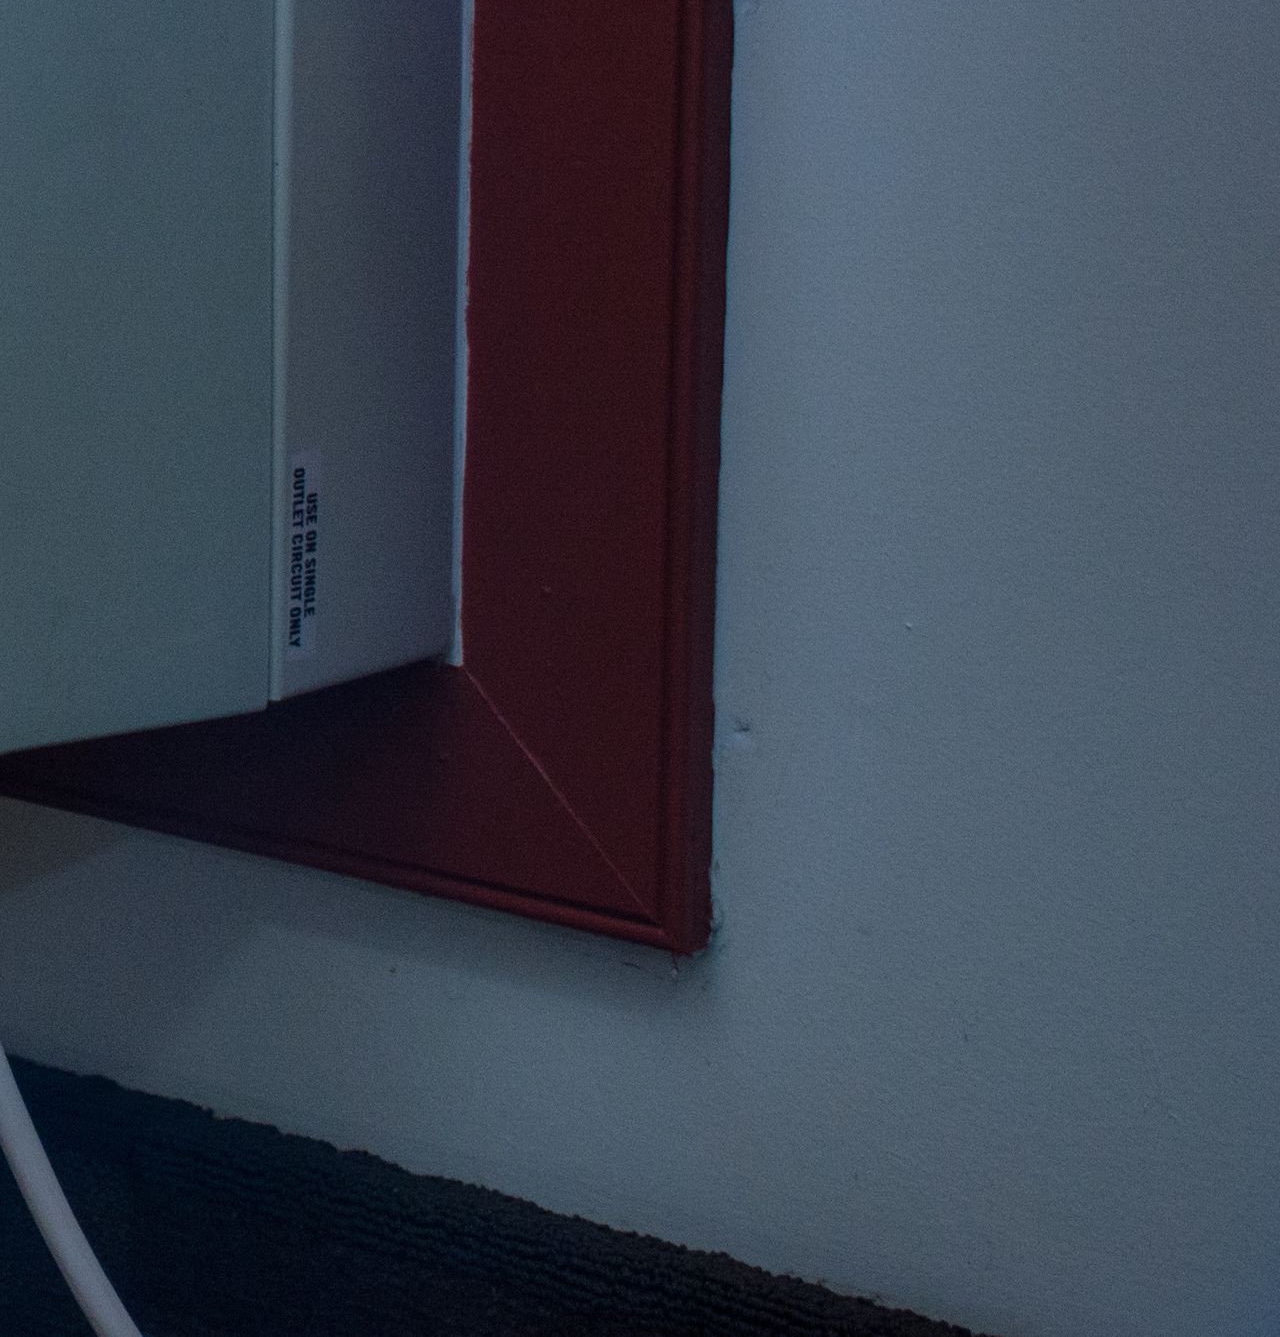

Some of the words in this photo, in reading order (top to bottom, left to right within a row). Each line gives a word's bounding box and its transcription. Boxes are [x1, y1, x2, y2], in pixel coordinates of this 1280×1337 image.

[292, 467, 305, 528] OUTLET
[306, 492, 318, 525] USE
[305, 530, 317, 553] ON
[290, 534, 304, 602] CIRCUIT
[303, 557, 317, 619] SINGLE
[289, 607, 302, 648] ONLY
